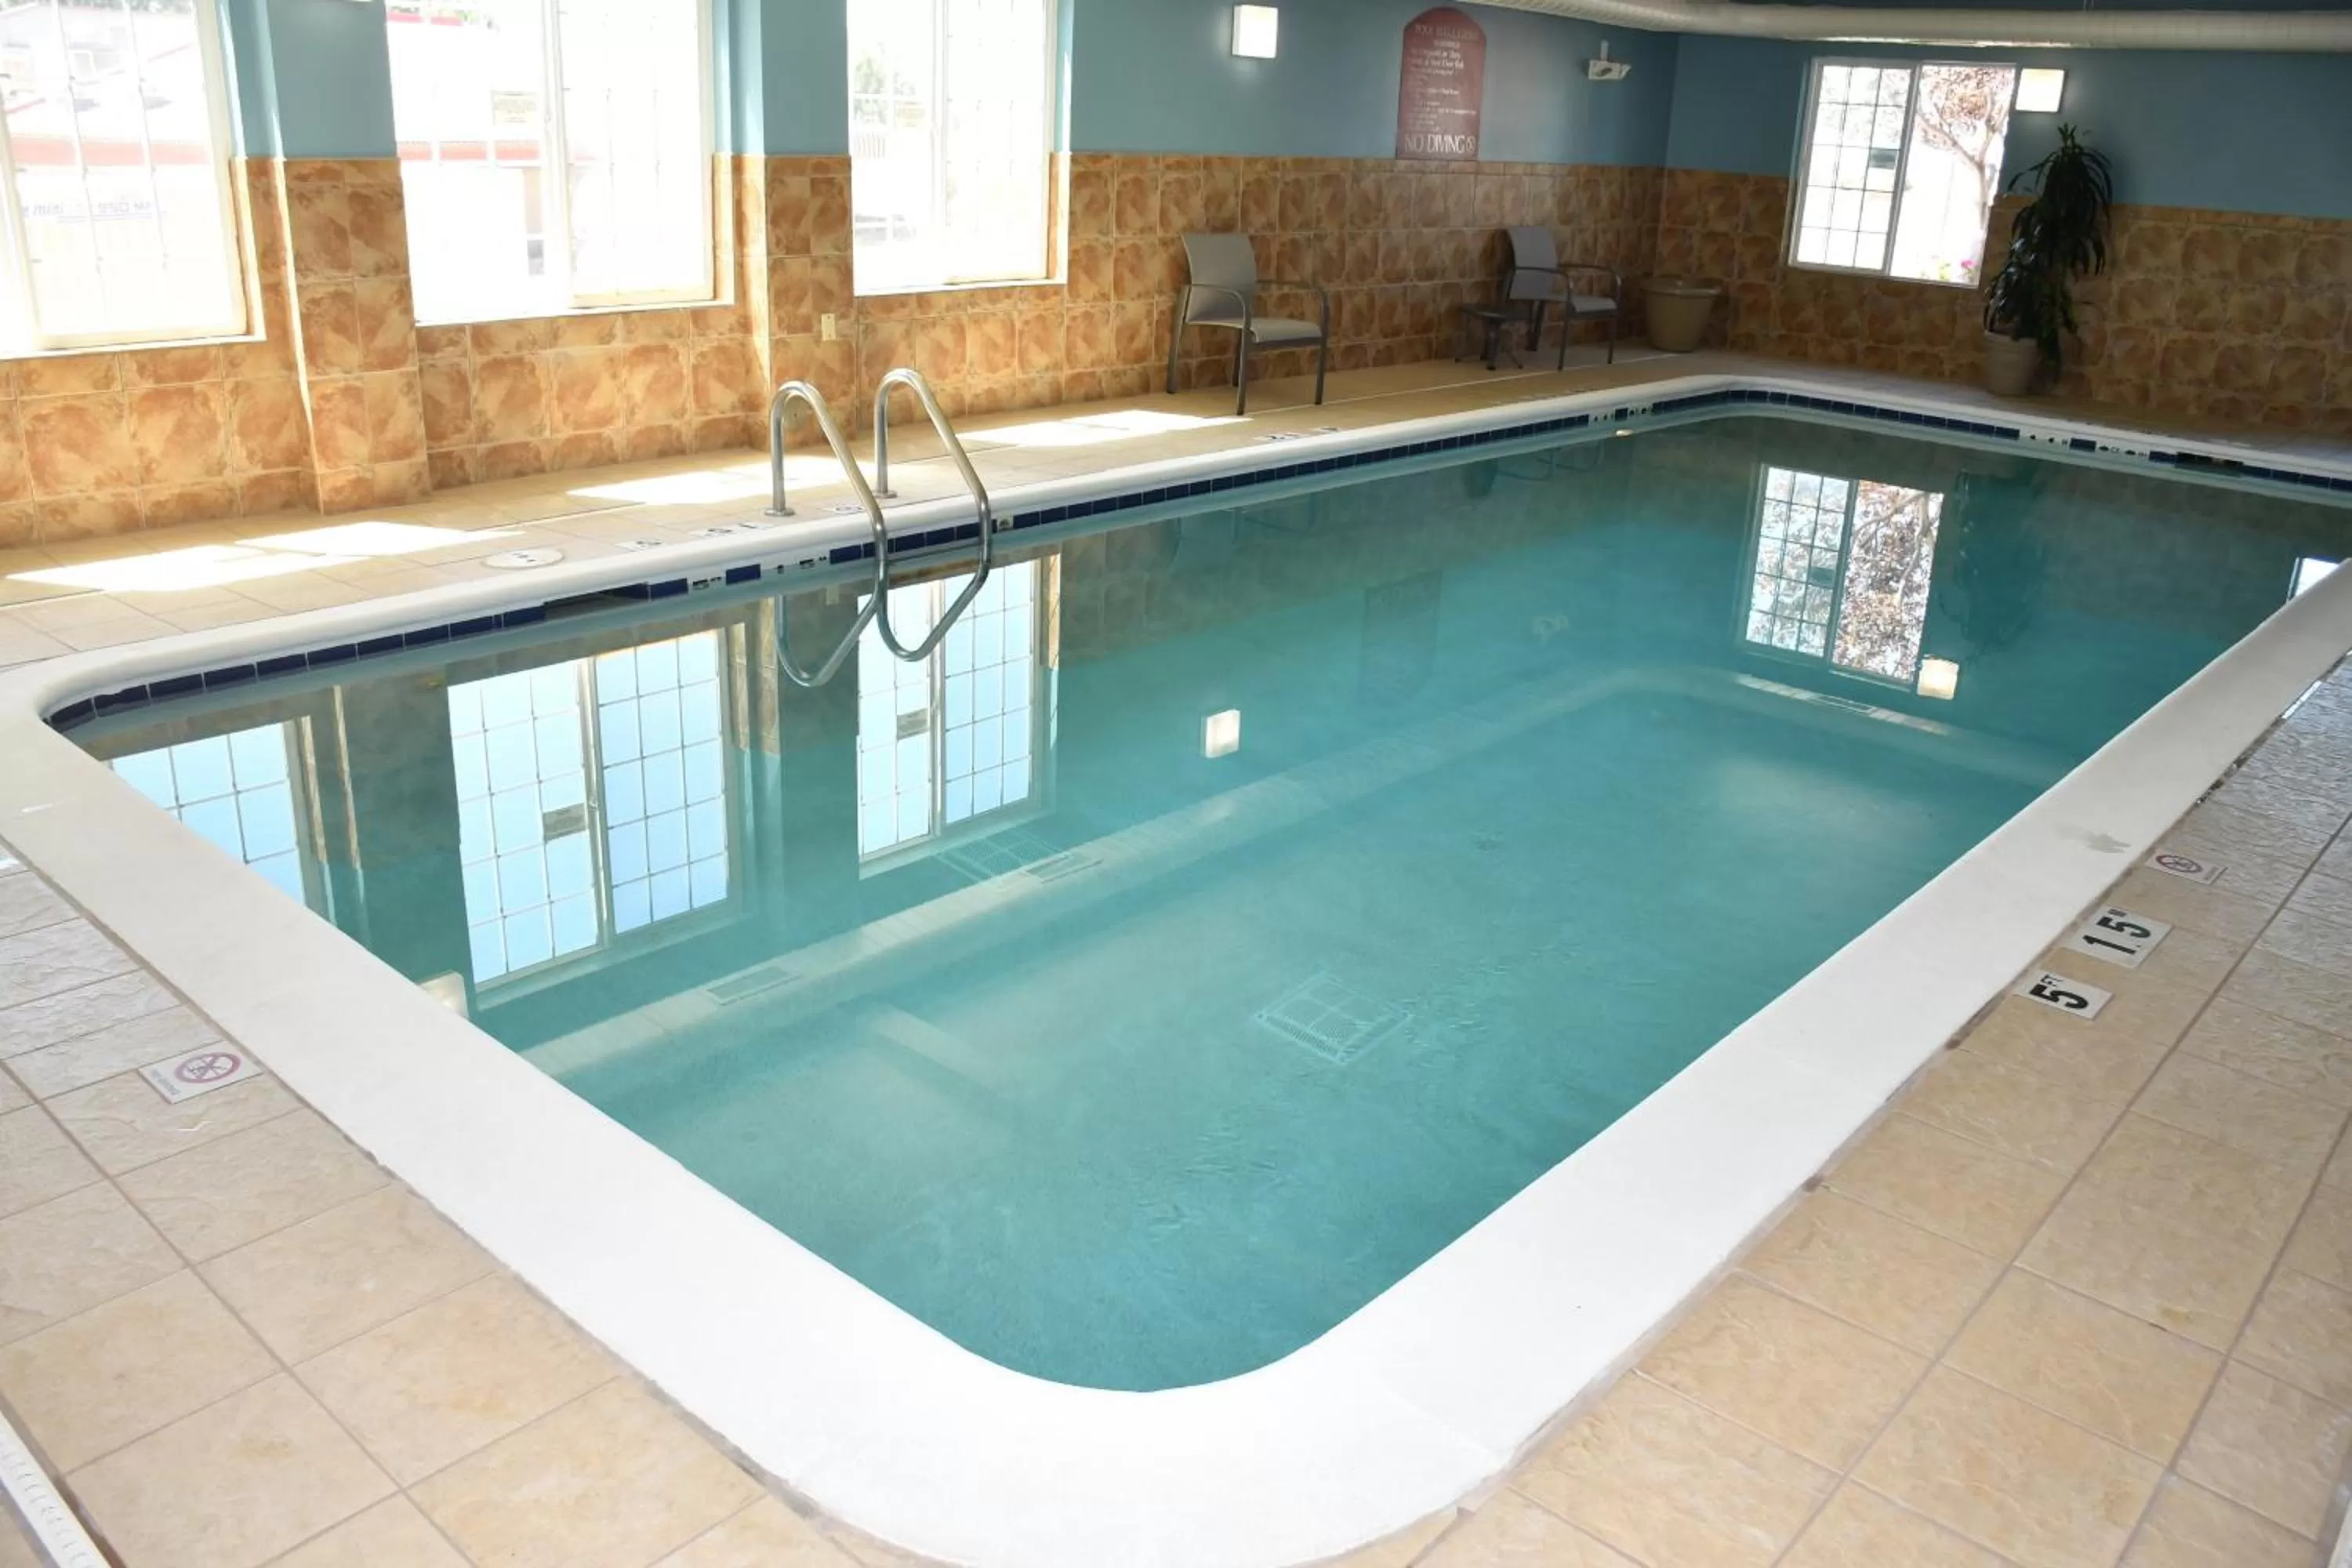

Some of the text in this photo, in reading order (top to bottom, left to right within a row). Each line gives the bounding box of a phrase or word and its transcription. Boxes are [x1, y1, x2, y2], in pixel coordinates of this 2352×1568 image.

[1404, 133, 1465, 154] NO DIVING
[2028, 982, 2089, 1010] 5
